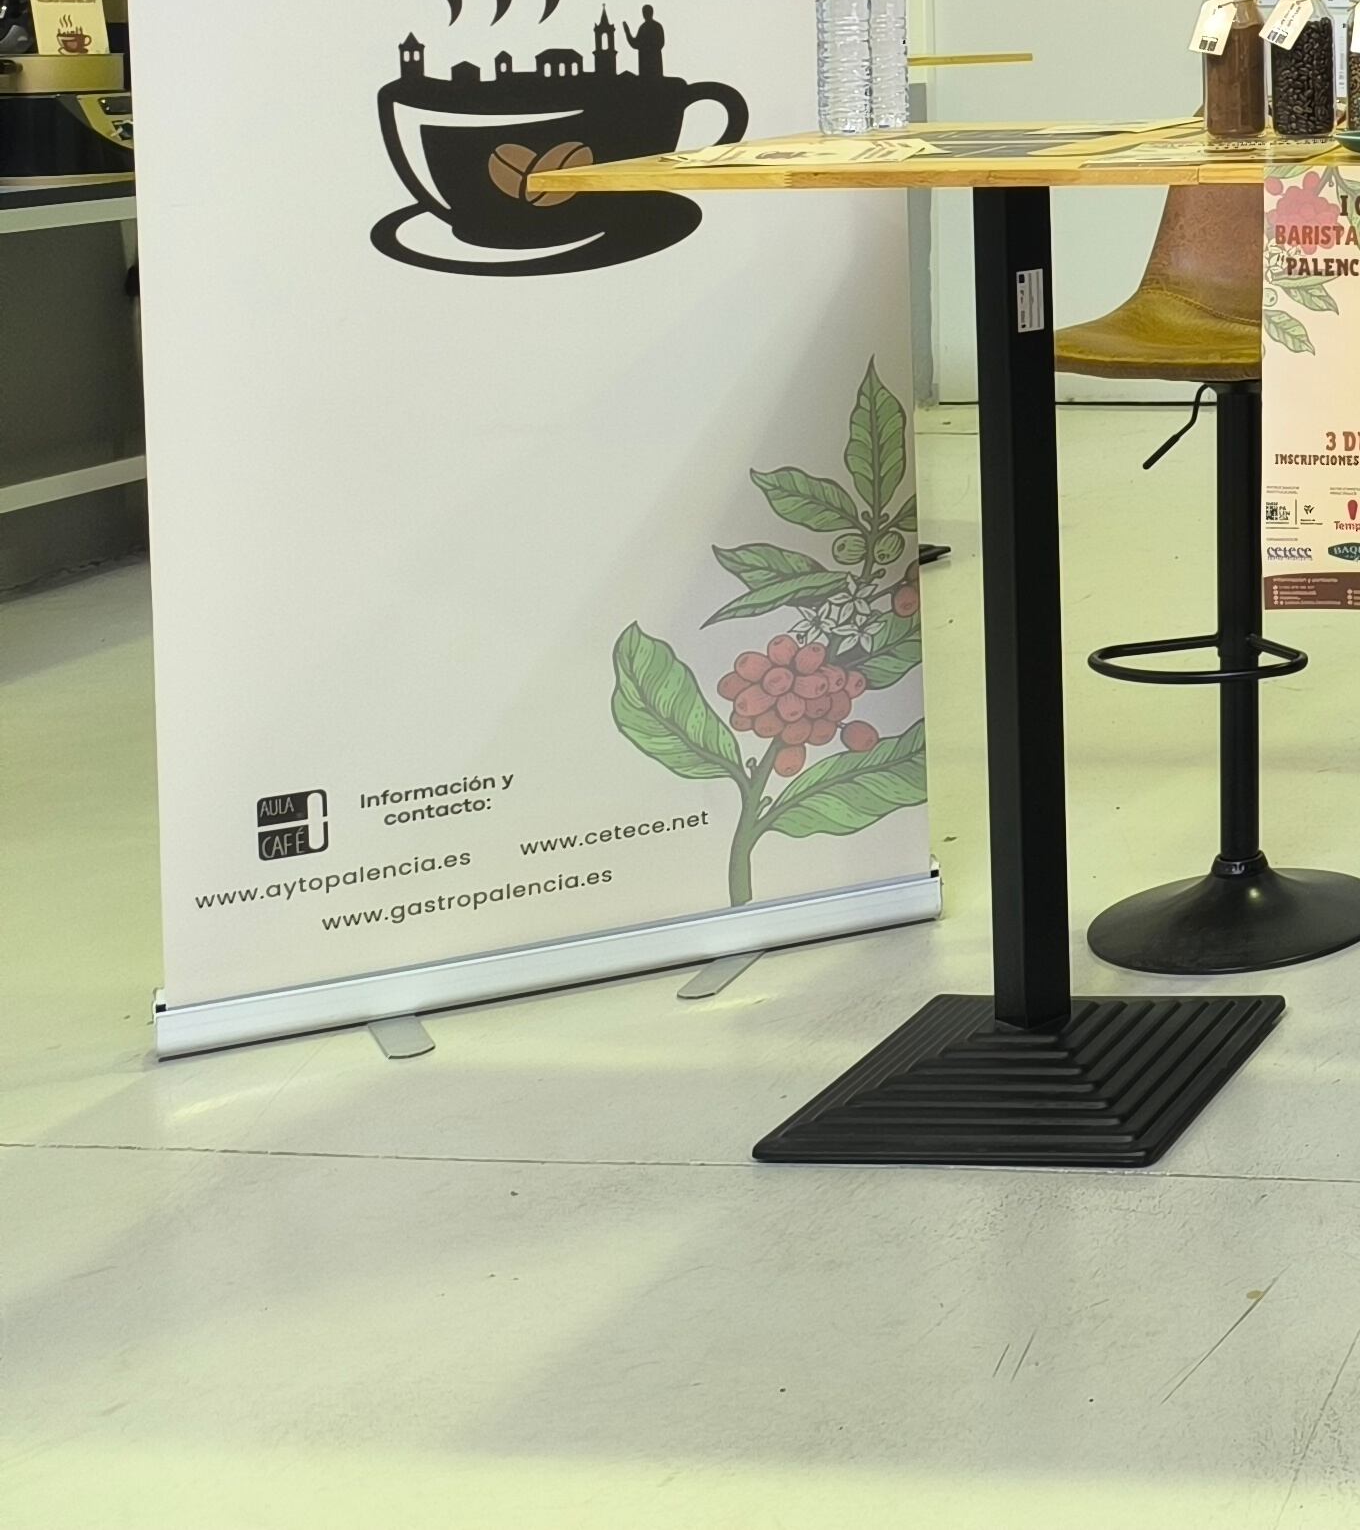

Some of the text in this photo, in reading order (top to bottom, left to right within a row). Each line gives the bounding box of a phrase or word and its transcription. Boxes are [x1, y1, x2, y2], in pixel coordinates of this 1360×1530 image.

[1340, 196, 1348, 217] I
[1275, 225, 1358, 245] BARISTA
[1326, 432, 1336, 451] 3
[1275, 454, 1359, 465] INSCRIPCIONES
[360, 773, 514, 810] Información y
[259, 797, 294, 818] AULA
[383, 795, 491, 827] contacto:
[262, 829, 305, 859] CAFÉ
[519, 810, 709, 856] www.cetece.net
[195, 849, 472, 909] www.aytopalencia.es
[321, 868, 613, 931] www.gastropalencia.es
